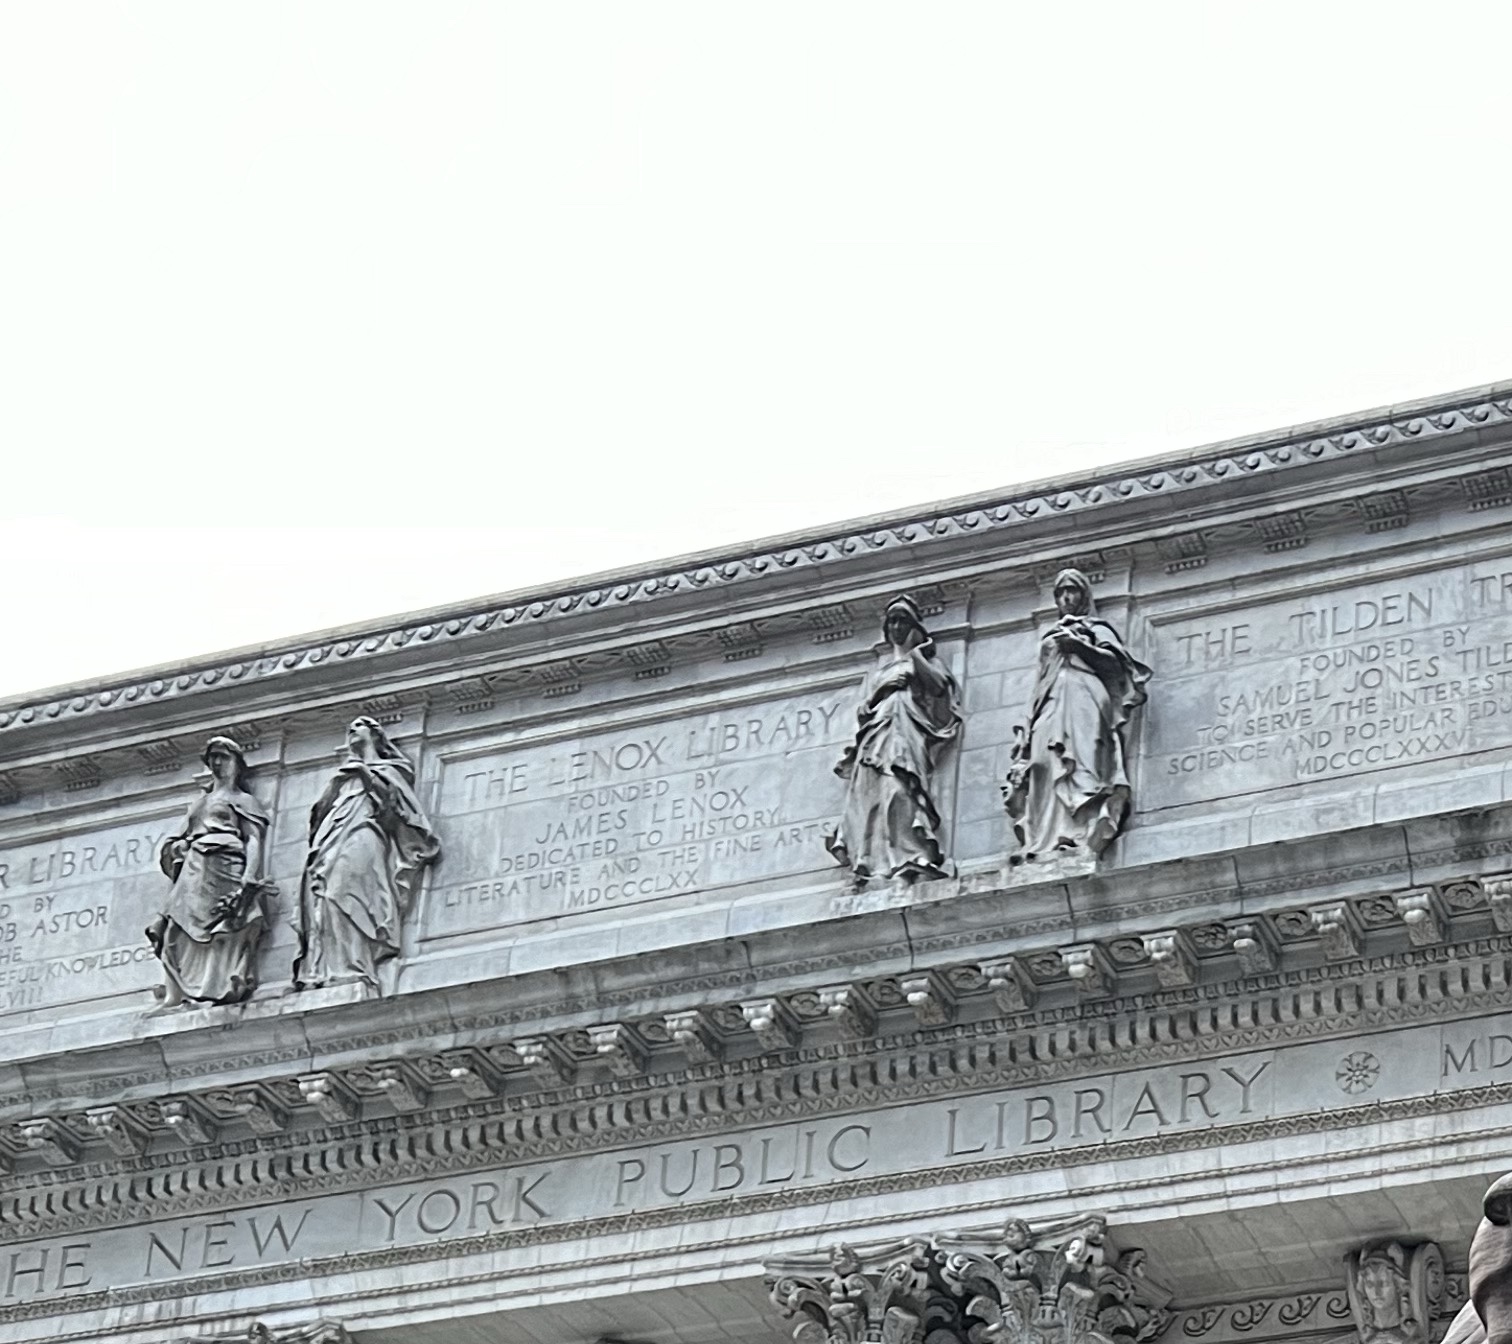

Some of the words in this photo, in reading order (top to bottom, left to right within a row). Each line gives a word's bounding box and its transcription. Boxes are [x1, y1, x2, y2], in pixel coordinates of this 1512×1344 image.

[1177, 624, 1252, 665] THE
[1289, 588, 1433, 647] TILDEN
[1300, 638, 1415, 676] FOUNDED
[1442, 627, 1471, 648] BY
[1217, 678, 1331, 719] SAMUEL
[1341, 656, 1441, 693] JONES
[1167, 741, 1270, 777] SCIENCE
[1283, 730, 1333, 754] AND
[1343, 708, 1454, 743] POPULAR
[1197, 724, 1228, 746] TO
[1243, 707, 1314, 737] SERVE
[1330, 696, 1377, 720] THE
[464, 764, 528, 806] THE
[547, 736, 667, 786] LENOX
[686, 703, 841, 761] LIBRARY
[536, 809, 627, 846] JAMES
[651, 786, 748, 825] LENOX
[568, 780, 670, 814] FOUNDED
[695, 769, 720, 790] BY
[30, 833, 165, 884] LIBRARY
[444, 867, 580, 908] LITERATURE
[599, 857, 641, 879] AND
[658, 844, 699, 866] THE
[715, 834, 763, 860] FINE
[774, 820, 832, 849] ARTS
[501, 838, 618, 873] DEDICATED
[632, 830, 663, 851] TO
[682, 807, 779, 841] HISTORY
[31, 906, 108, 938] ASTOR
[34, 895, 57, 913] BY
[145, 1208, 313, 1276] NEW
[374, 1171, 551, 1241] YORK
[614, 1125, 872, 1208] PUBLIC
[948, 1061, 1272, 1159] LIBRARY
